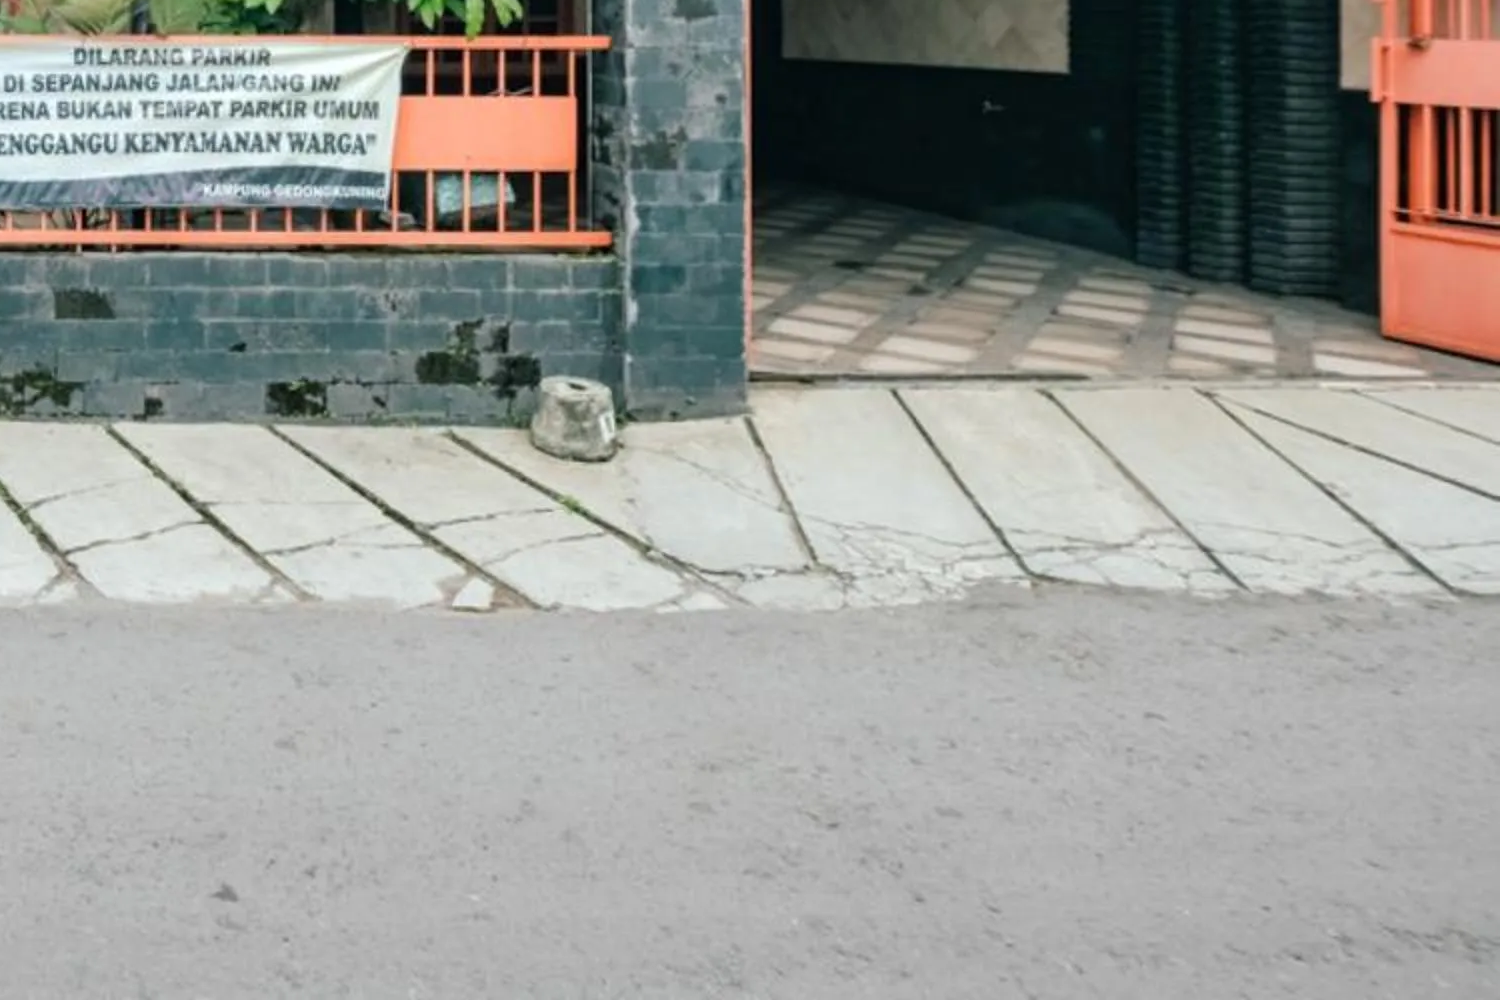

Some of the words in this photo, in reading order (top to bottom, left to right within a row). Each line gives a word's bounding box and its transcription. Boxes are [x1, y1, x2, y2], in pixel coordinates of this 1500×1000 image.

[73, 47, 184, 66] DILARANG
[191, 48, 271, 66] PARKIR
[3, 74, 25, 93] DI
[31, 72, 160, 93] SEPANJANG
[56, 100, 133, 120] BUKAN
[139, 100, 223, 119] TEMPAT
[229, 100, 307, 119] PARKIR
[313, 101, 379, 120] UMUM
[124, 132, 282, 154] KENYAMANAN
[203, 184, 270, 198] KAMPUNG
